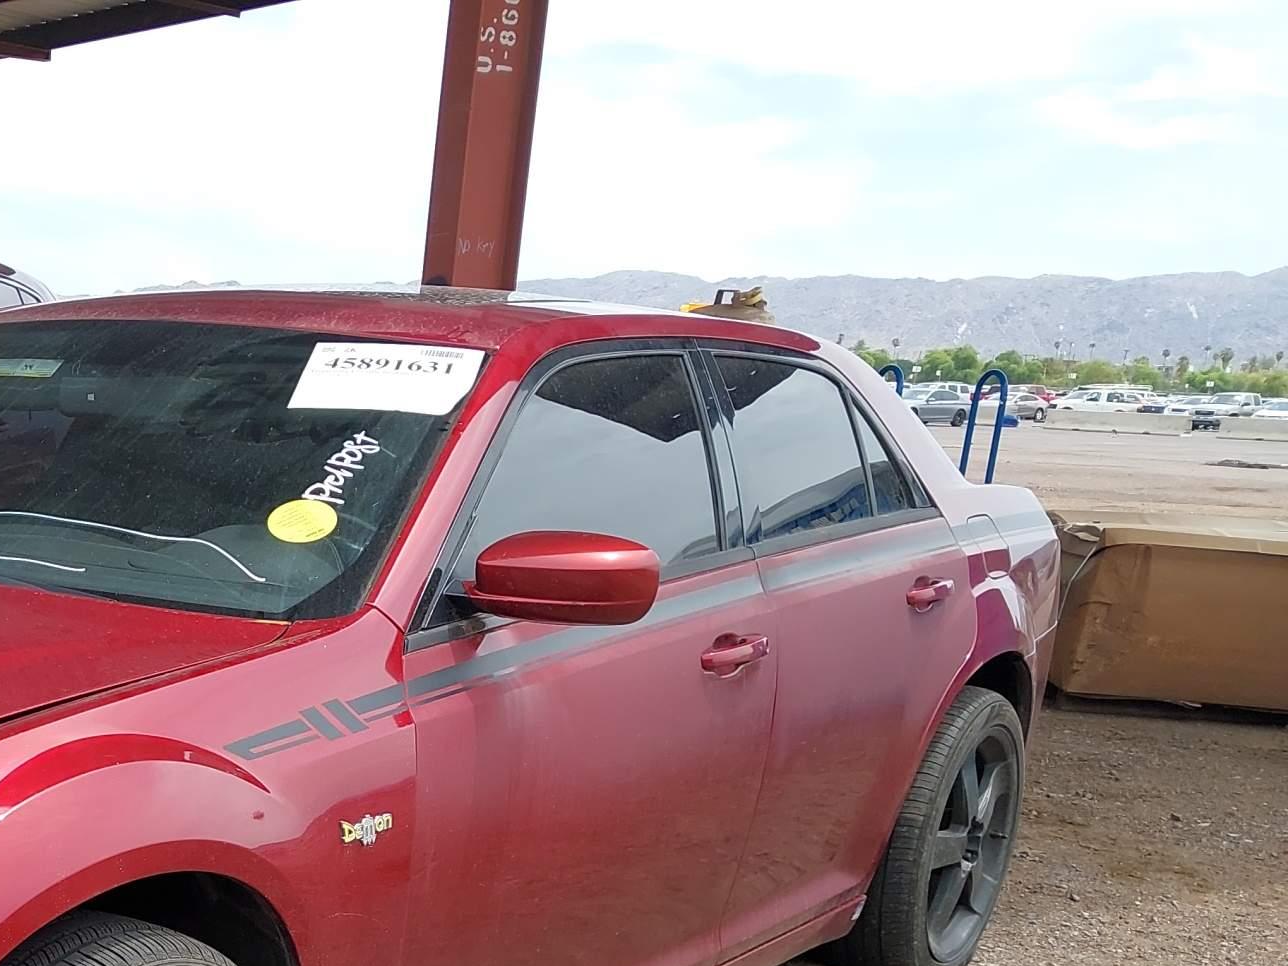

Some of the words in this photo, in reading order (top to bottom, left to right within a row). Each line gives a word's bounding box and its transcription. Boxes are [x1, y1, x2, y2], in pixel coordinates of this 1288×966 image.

[476, 18, 498, 73] U.S.
[496, 0, 520, 72] 1-86
[324, 357, 454, 375] 45891631
